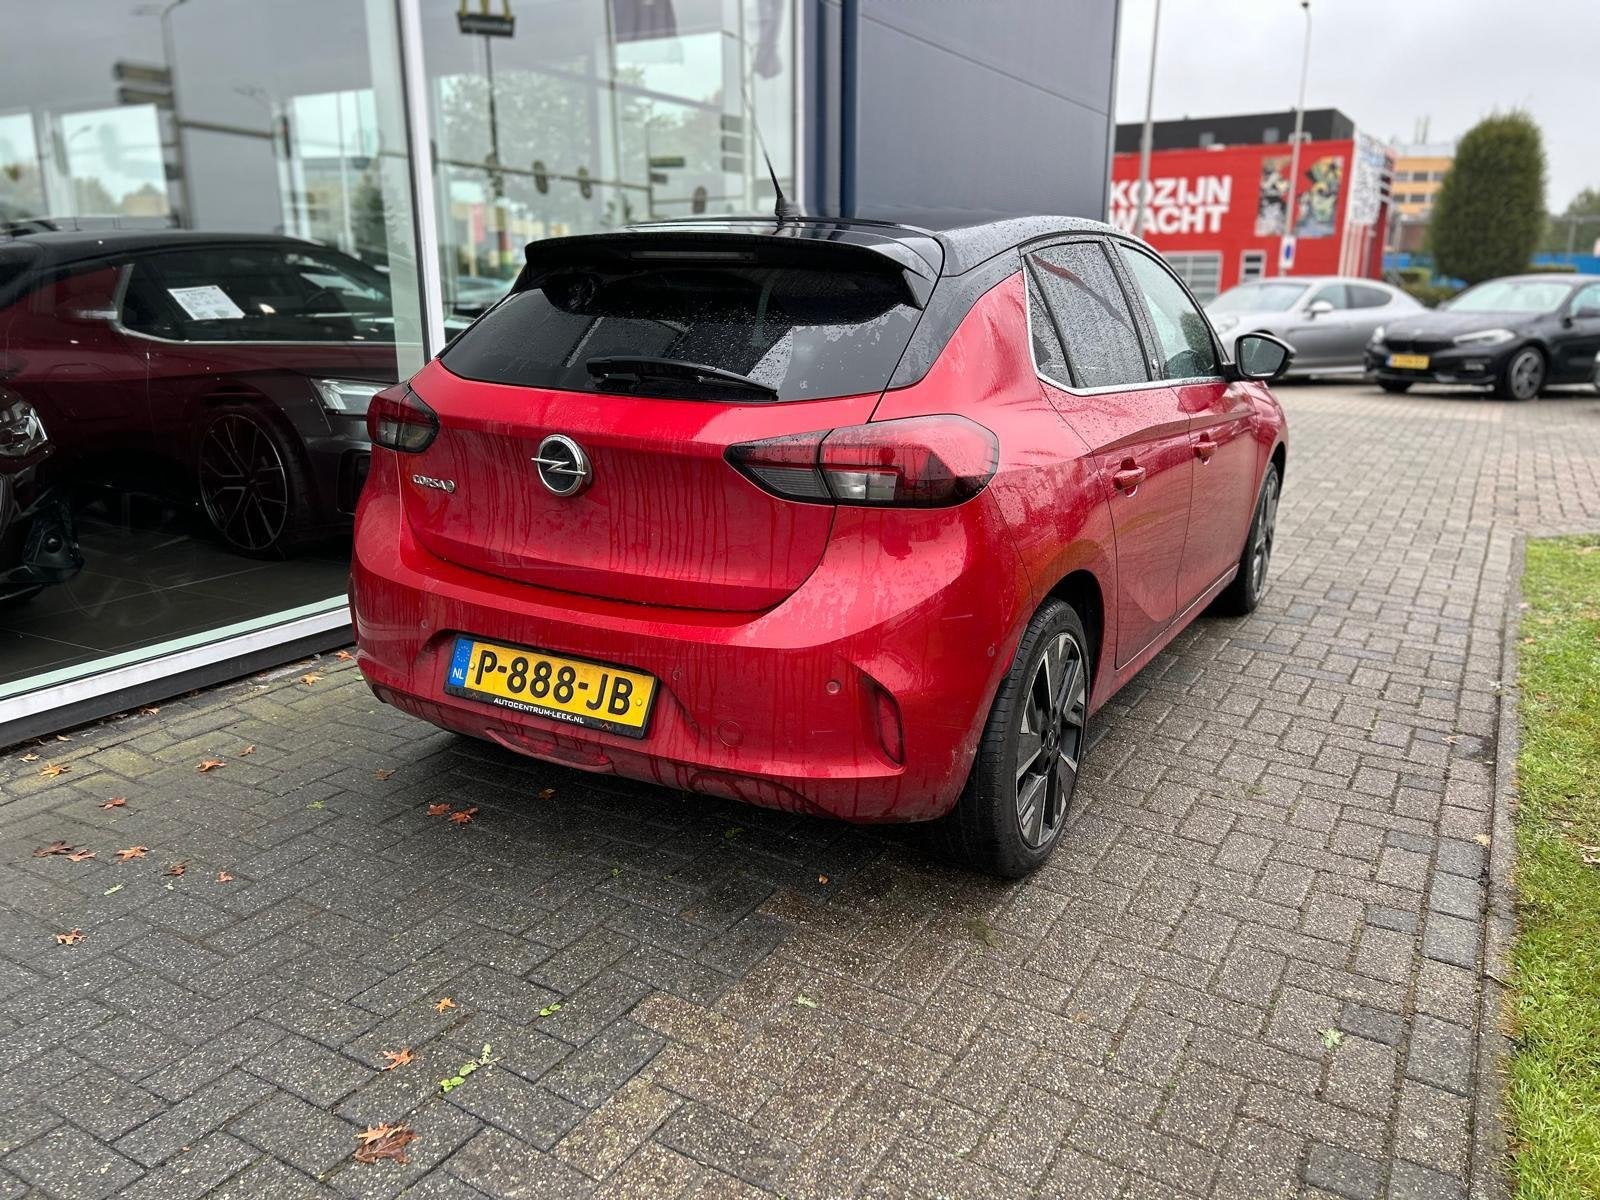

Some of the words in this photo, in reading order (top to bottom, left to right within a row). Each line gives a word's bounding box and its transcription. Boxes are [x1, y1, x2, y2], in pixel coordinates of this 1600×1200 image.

[1110, 175, 1232, 207] KOZIJN
[1108, 204, 1229, 235] WACHT
[452, 667, 465, 680] NL
[475, 650, 633, 716] P-888-JB
[494, 697, 585, 724] AUTOCENTRUM-LEEK.NL
